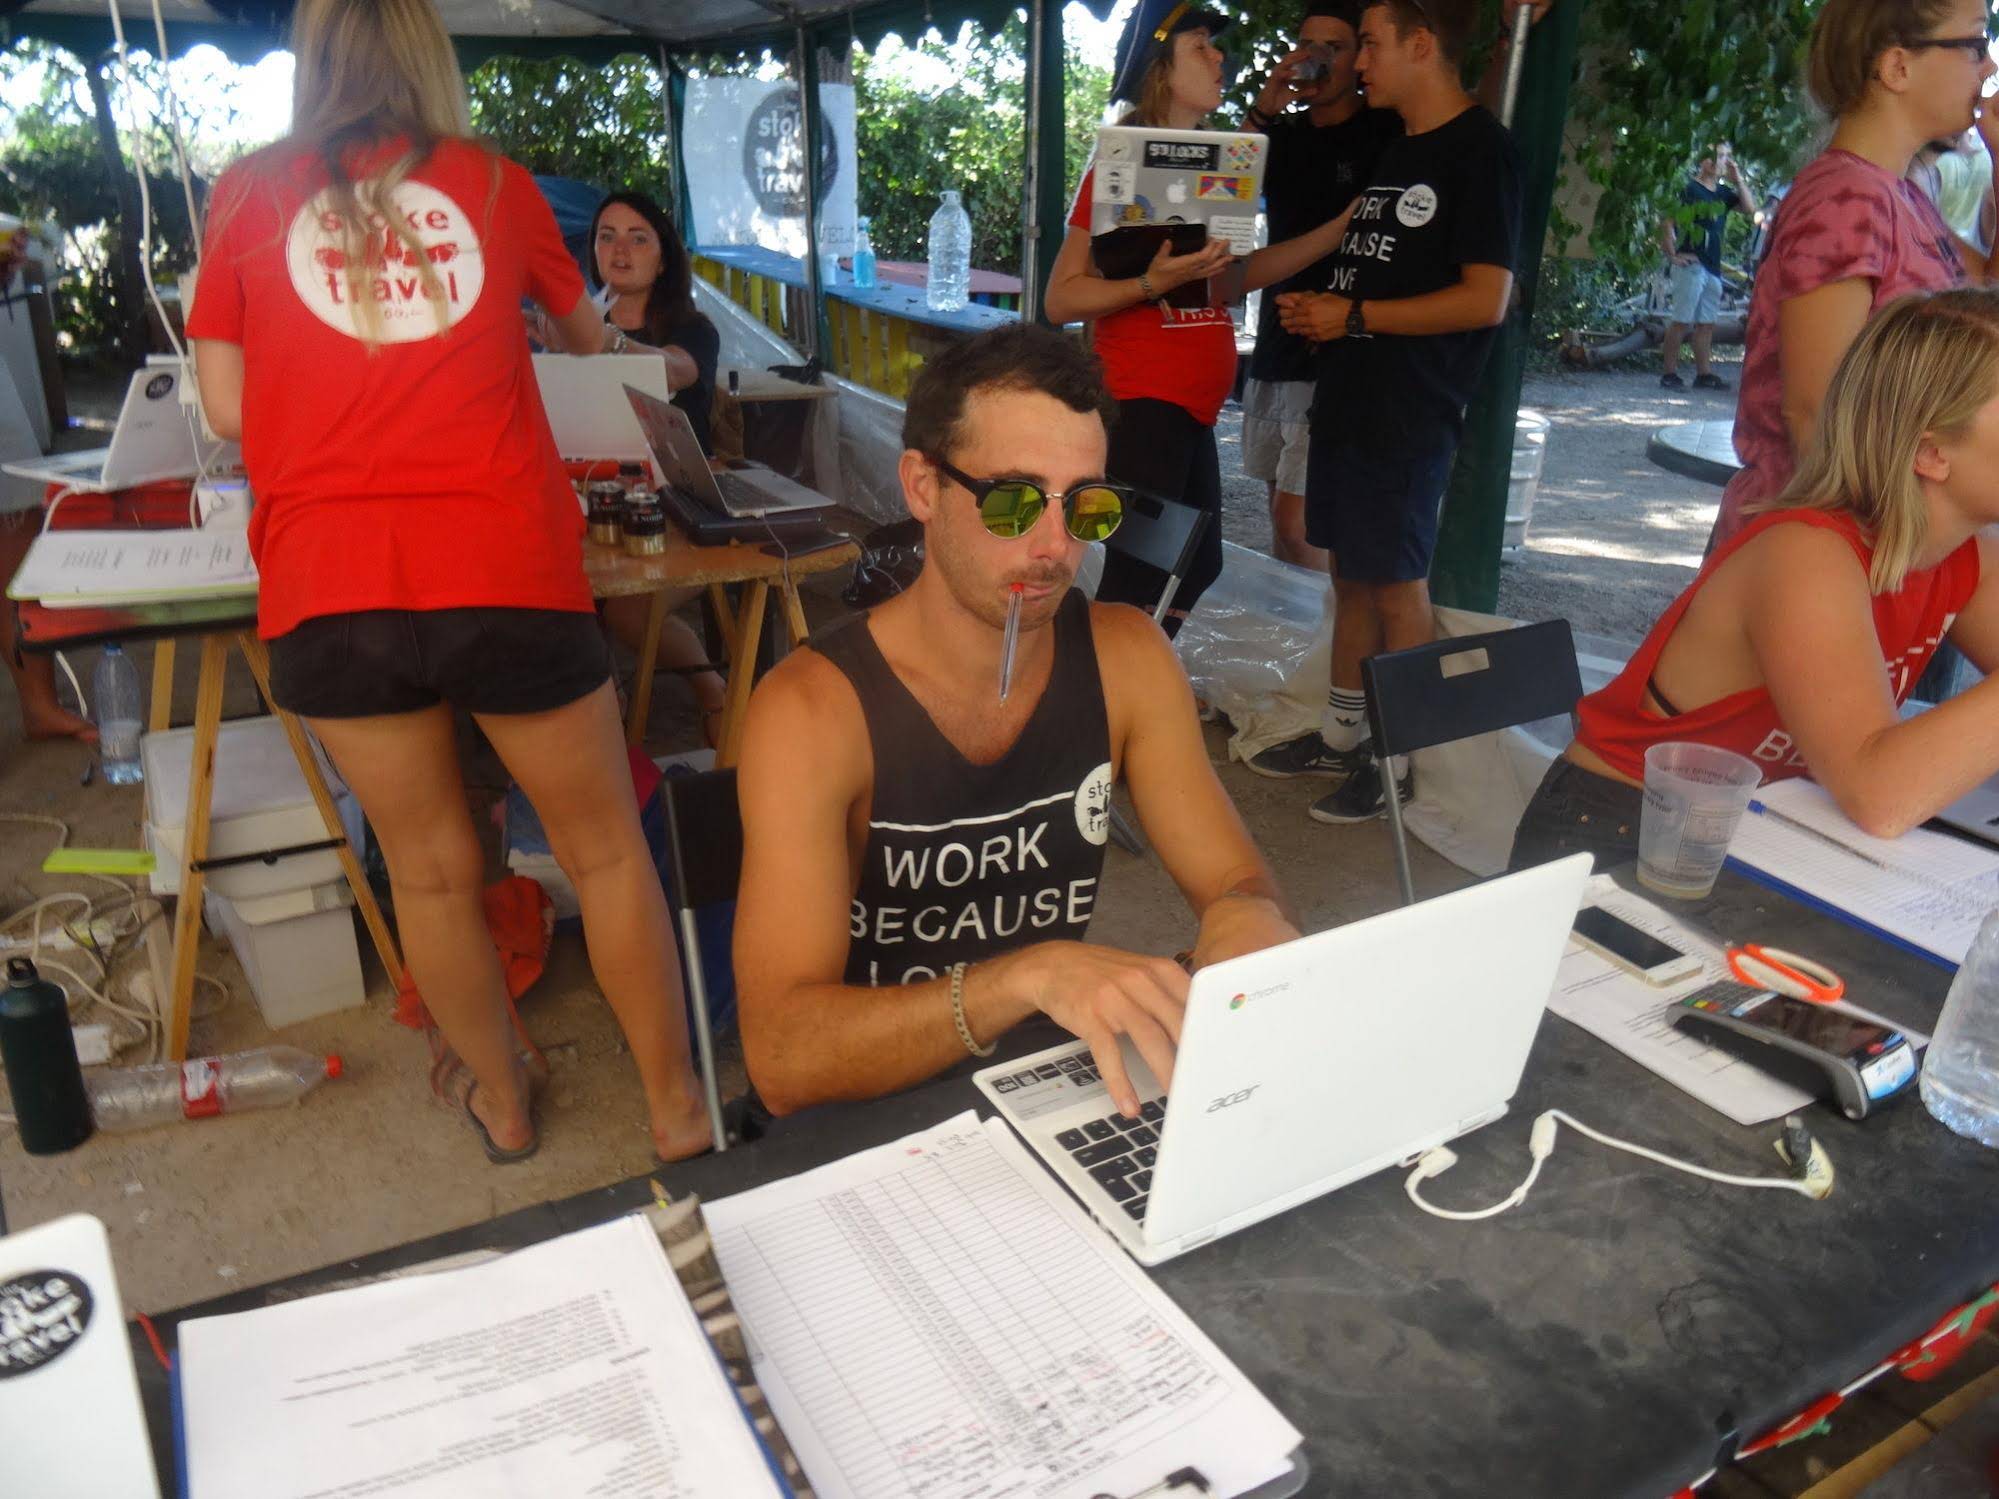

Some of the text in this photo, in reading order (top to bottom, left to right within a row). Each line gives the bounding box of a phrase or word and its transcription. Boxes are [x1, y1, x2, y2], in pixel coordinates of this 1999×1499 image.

[757, 110, 803, 138] sto
[756, 166, 804, 193] trav
[1353, 197, 1390, 220] RK
[1087, 780, 1111, 799] sto
[1088, 816, 1109, 832] tra
[884, 822, 1049, 890] WORK
[850, 877, 1097, 945] BECAUSE
[1206, 1084, 1261, 1113] acer
